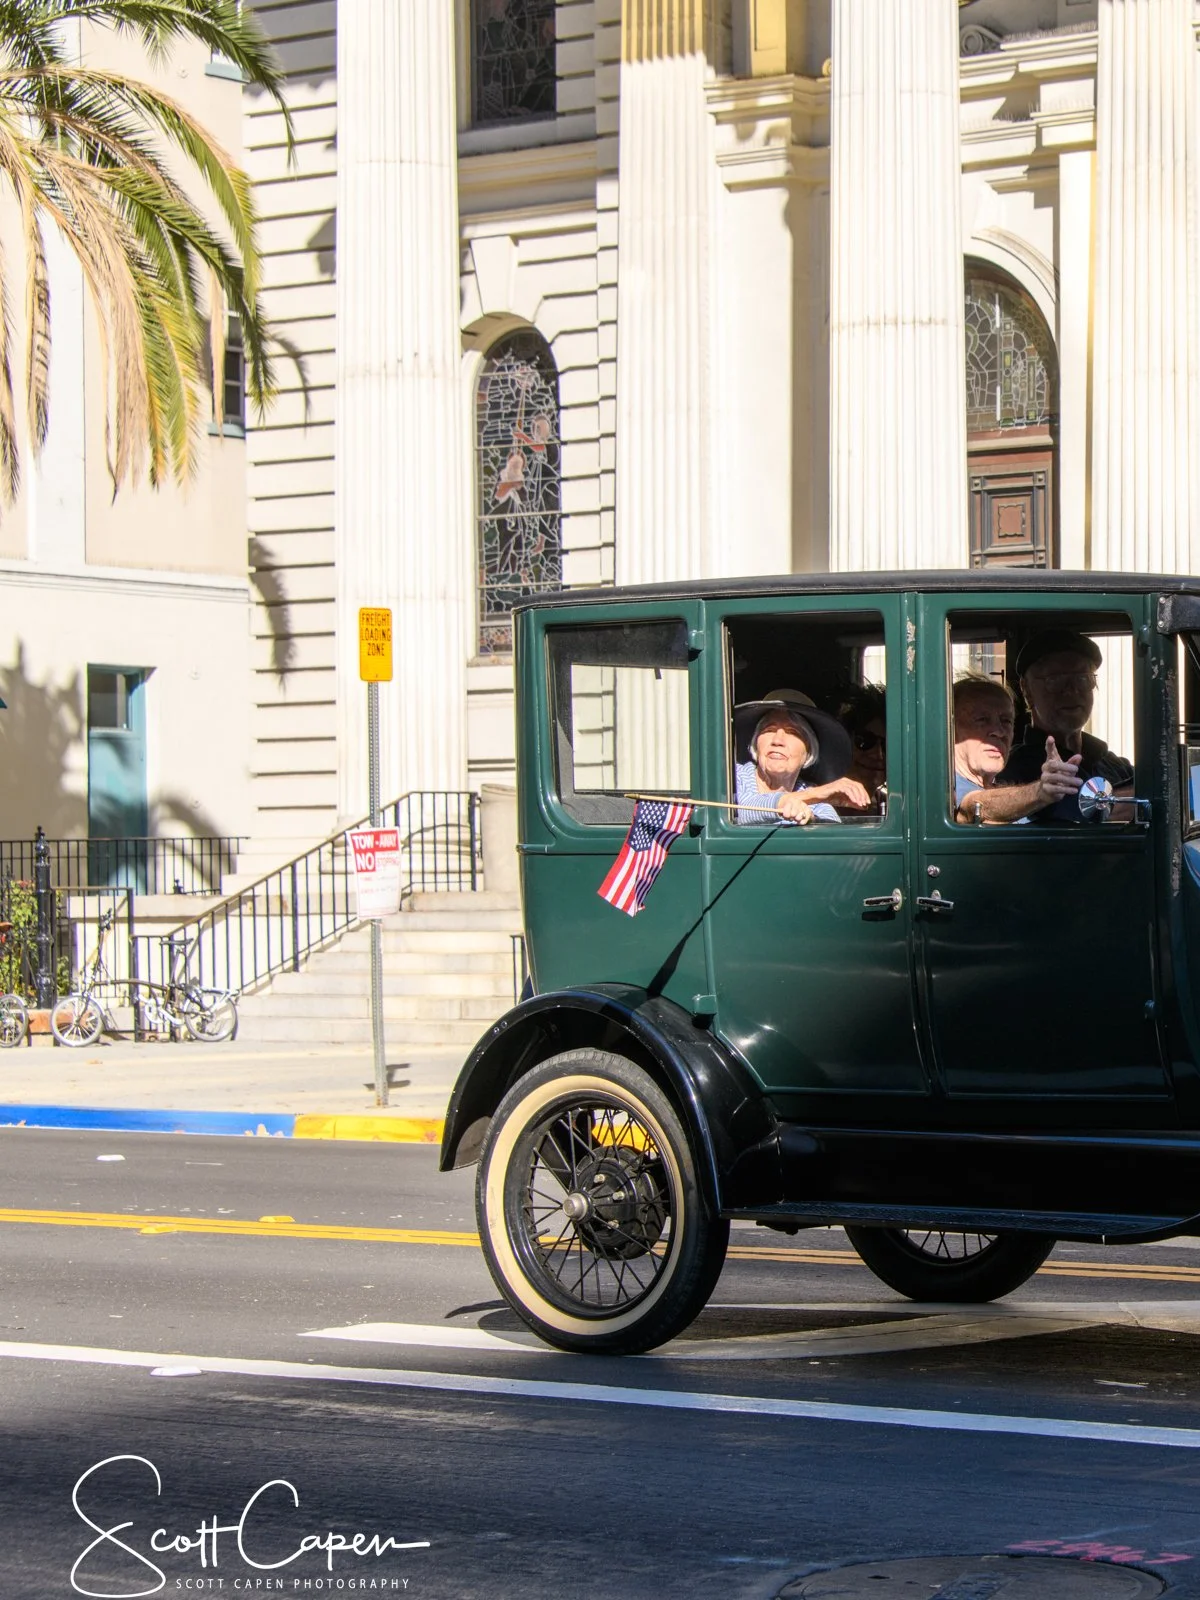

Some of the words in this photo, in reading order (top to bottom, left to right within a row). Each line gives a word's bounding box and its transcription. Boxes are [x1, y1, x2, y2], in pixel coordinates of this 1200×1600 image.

[361, 612, 391, 626] FREIGHT
[361, 628, 391, 641] LOADING
[367, 643, 385, 656] ZONE
[355, 851, 375, 870] NO
